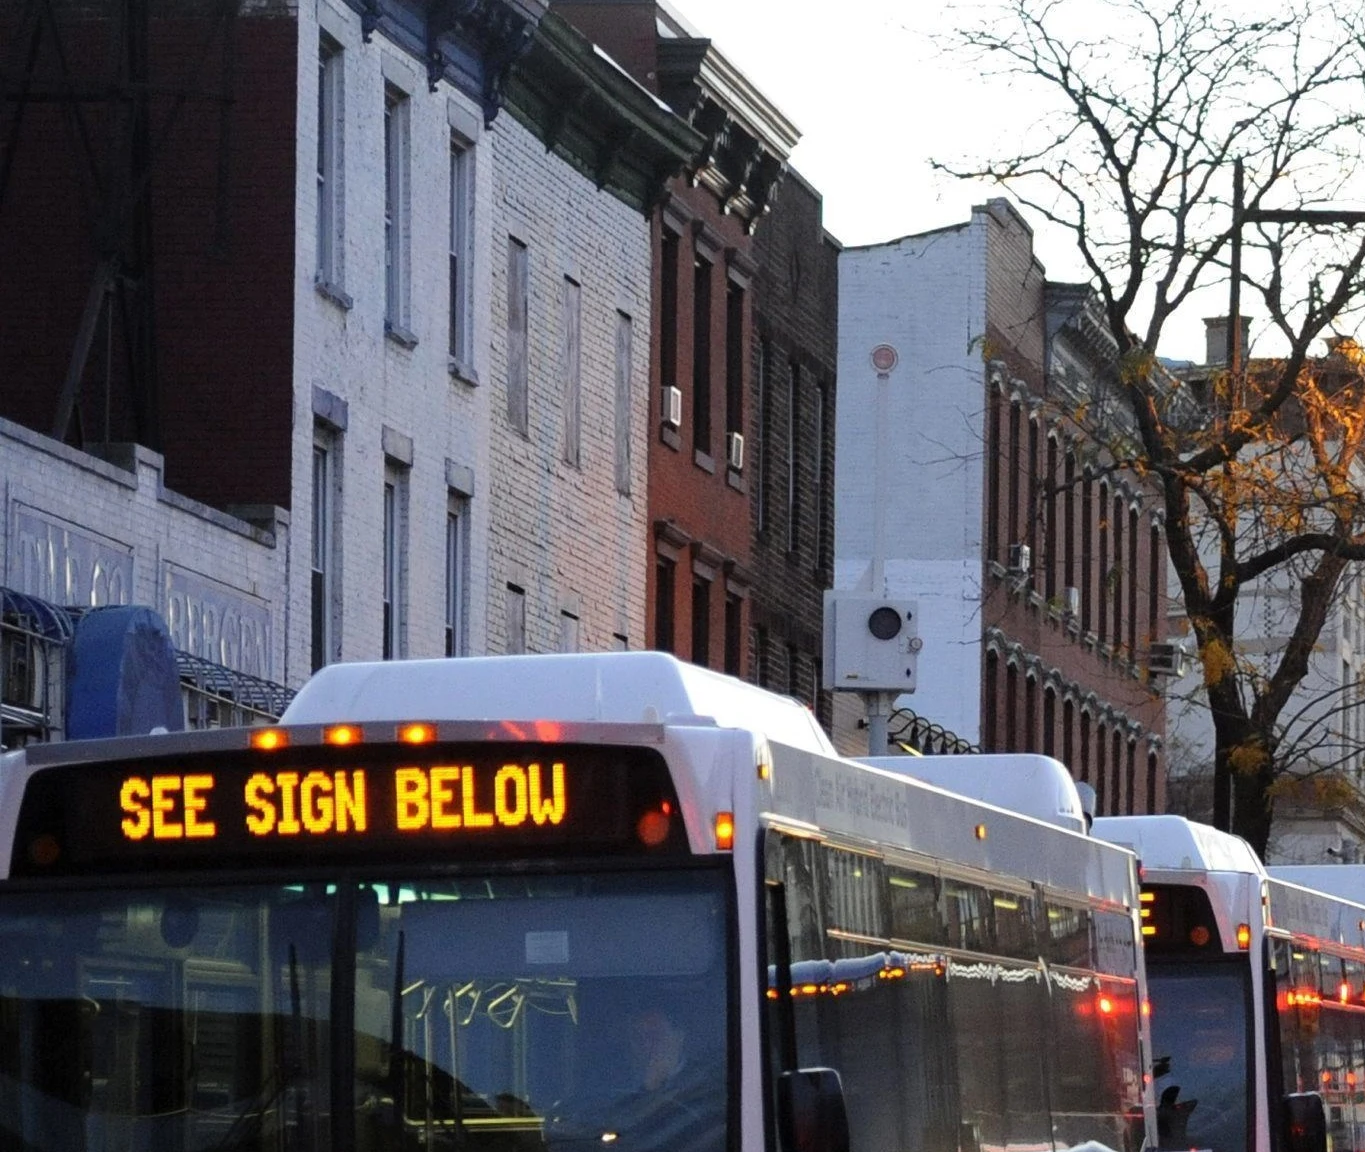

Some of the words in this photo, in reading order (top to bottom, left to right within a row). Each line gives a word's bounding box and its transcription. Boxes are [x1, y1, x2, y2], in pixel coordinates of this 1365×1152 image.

[120, 775, 216, 839] SEE
[244, 770, 367, 835] SIGN
[396, 763, 566, 830] BELOW
